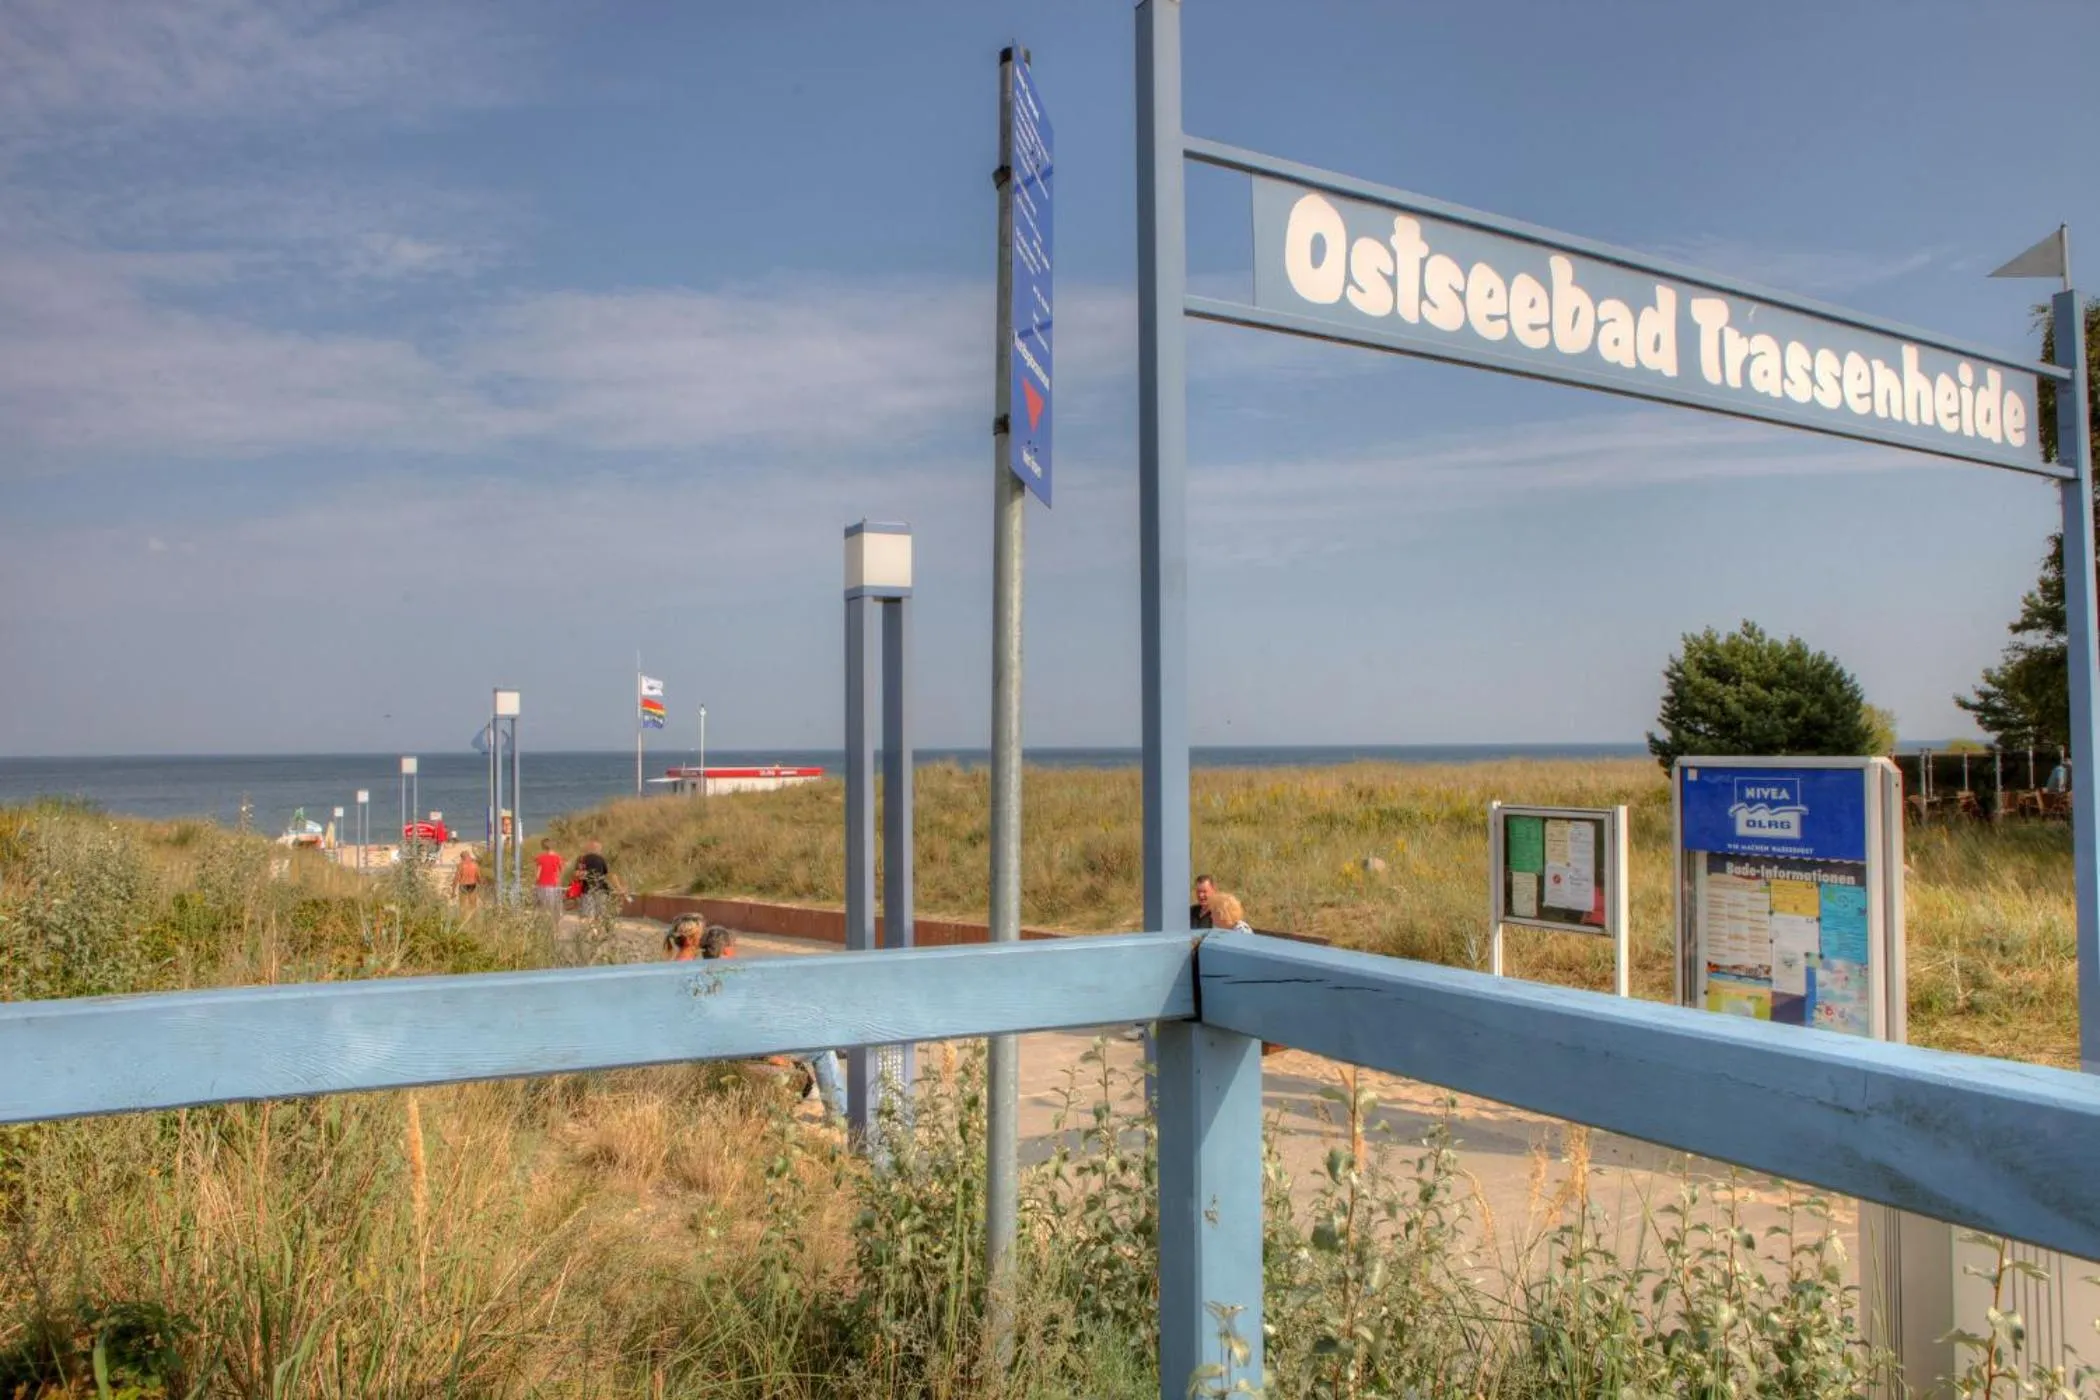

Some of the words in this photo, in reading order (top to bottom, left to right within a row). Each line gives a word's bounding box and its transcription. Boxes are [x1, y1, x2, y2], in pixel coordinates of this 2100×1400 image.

[1285, 193, 1677, 377] Ostseebad
[1691, 297, 2026, 448] Trassenheide
[1744, 787, 1790, 800] NIVEA
[1746, 819, 1792, 830] DLRG
[1725, 861, 1856, 885] Bade-Informationen
